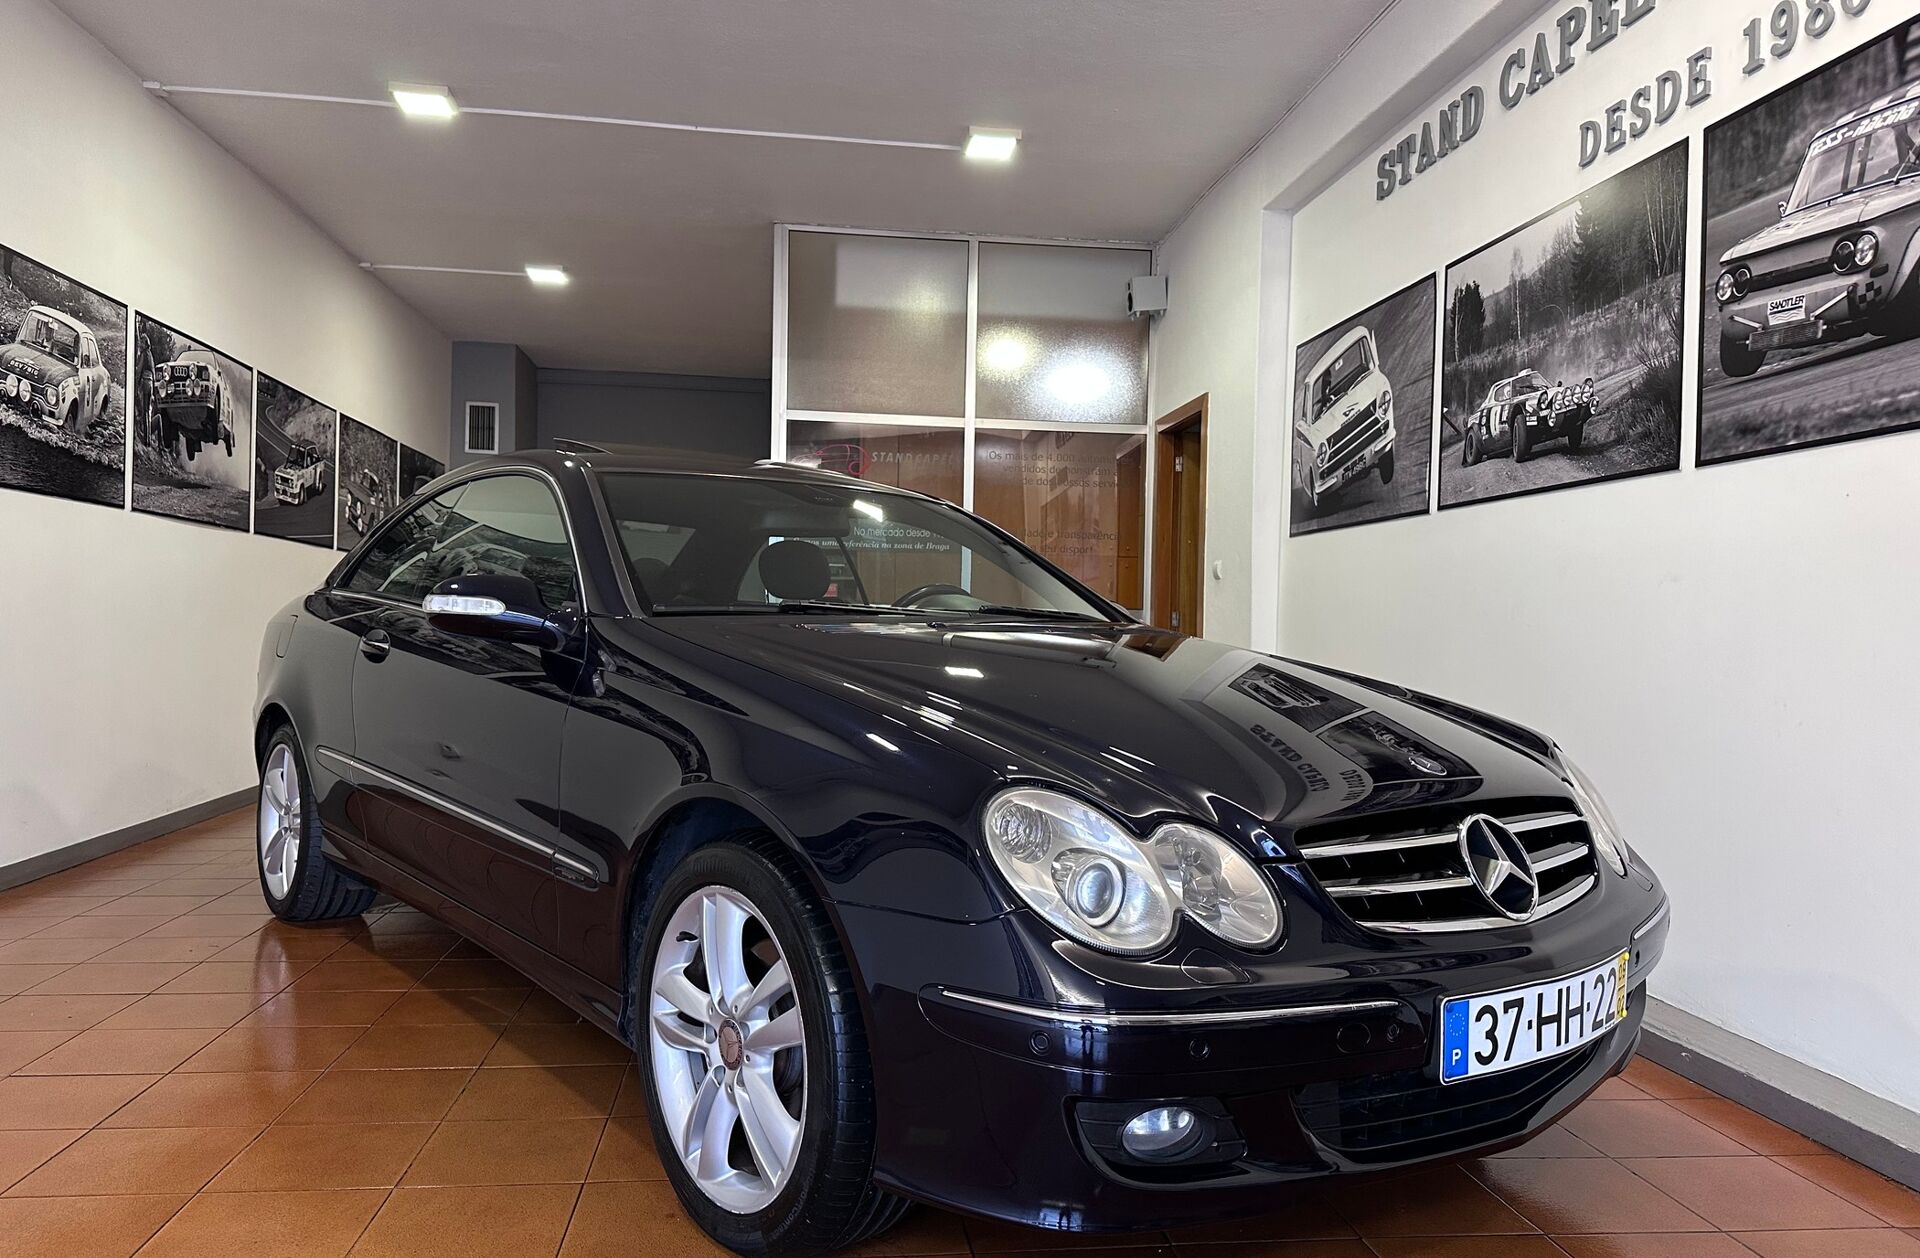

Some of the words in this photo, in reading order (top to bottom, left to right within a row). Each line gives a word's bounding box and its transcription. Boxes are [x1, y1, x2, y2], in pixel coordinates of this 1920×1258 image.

[1579, 46, 1712, 167] DESDE
[1376, 85, 1485, 200] STAND
[854, 527, 866, 536] No
[867, 527, 904, 537] mercado
[1452, 1049, 1462, 1066] P
